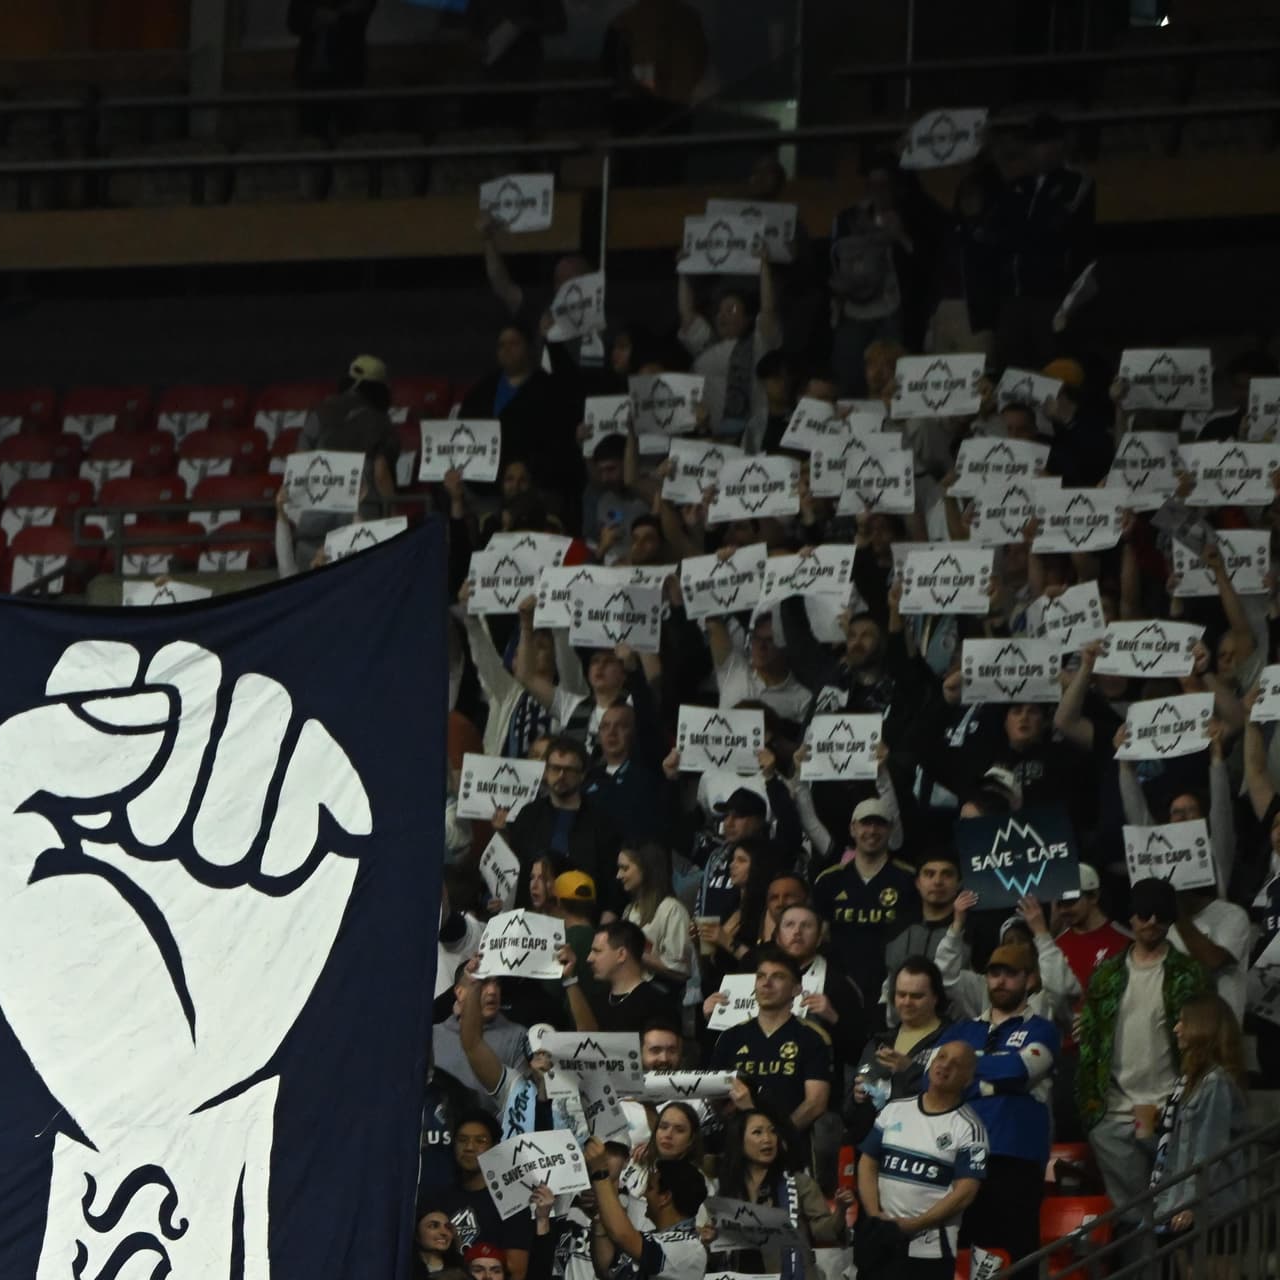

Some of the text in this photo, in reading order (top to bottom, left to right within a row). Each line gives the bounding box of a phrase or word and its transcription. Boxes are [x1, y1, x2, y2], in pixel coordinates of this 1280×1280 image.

[917, 576, 937, 587] SAVE
[953, 575, 974, 586] CAPS
[1117, 640, 1139, 651] SAVE
[1155, 641, 1180, 652] CAPS
[690, 734, 709, 746] SAVE
[725, 736, 747, 747] CAPS
[971, 842, 1069, 873] SAVE CAPS
[501, 1154, 565, 1186] SAVE THE CAPS
[883, 1154, 939, 1179] TELUS
